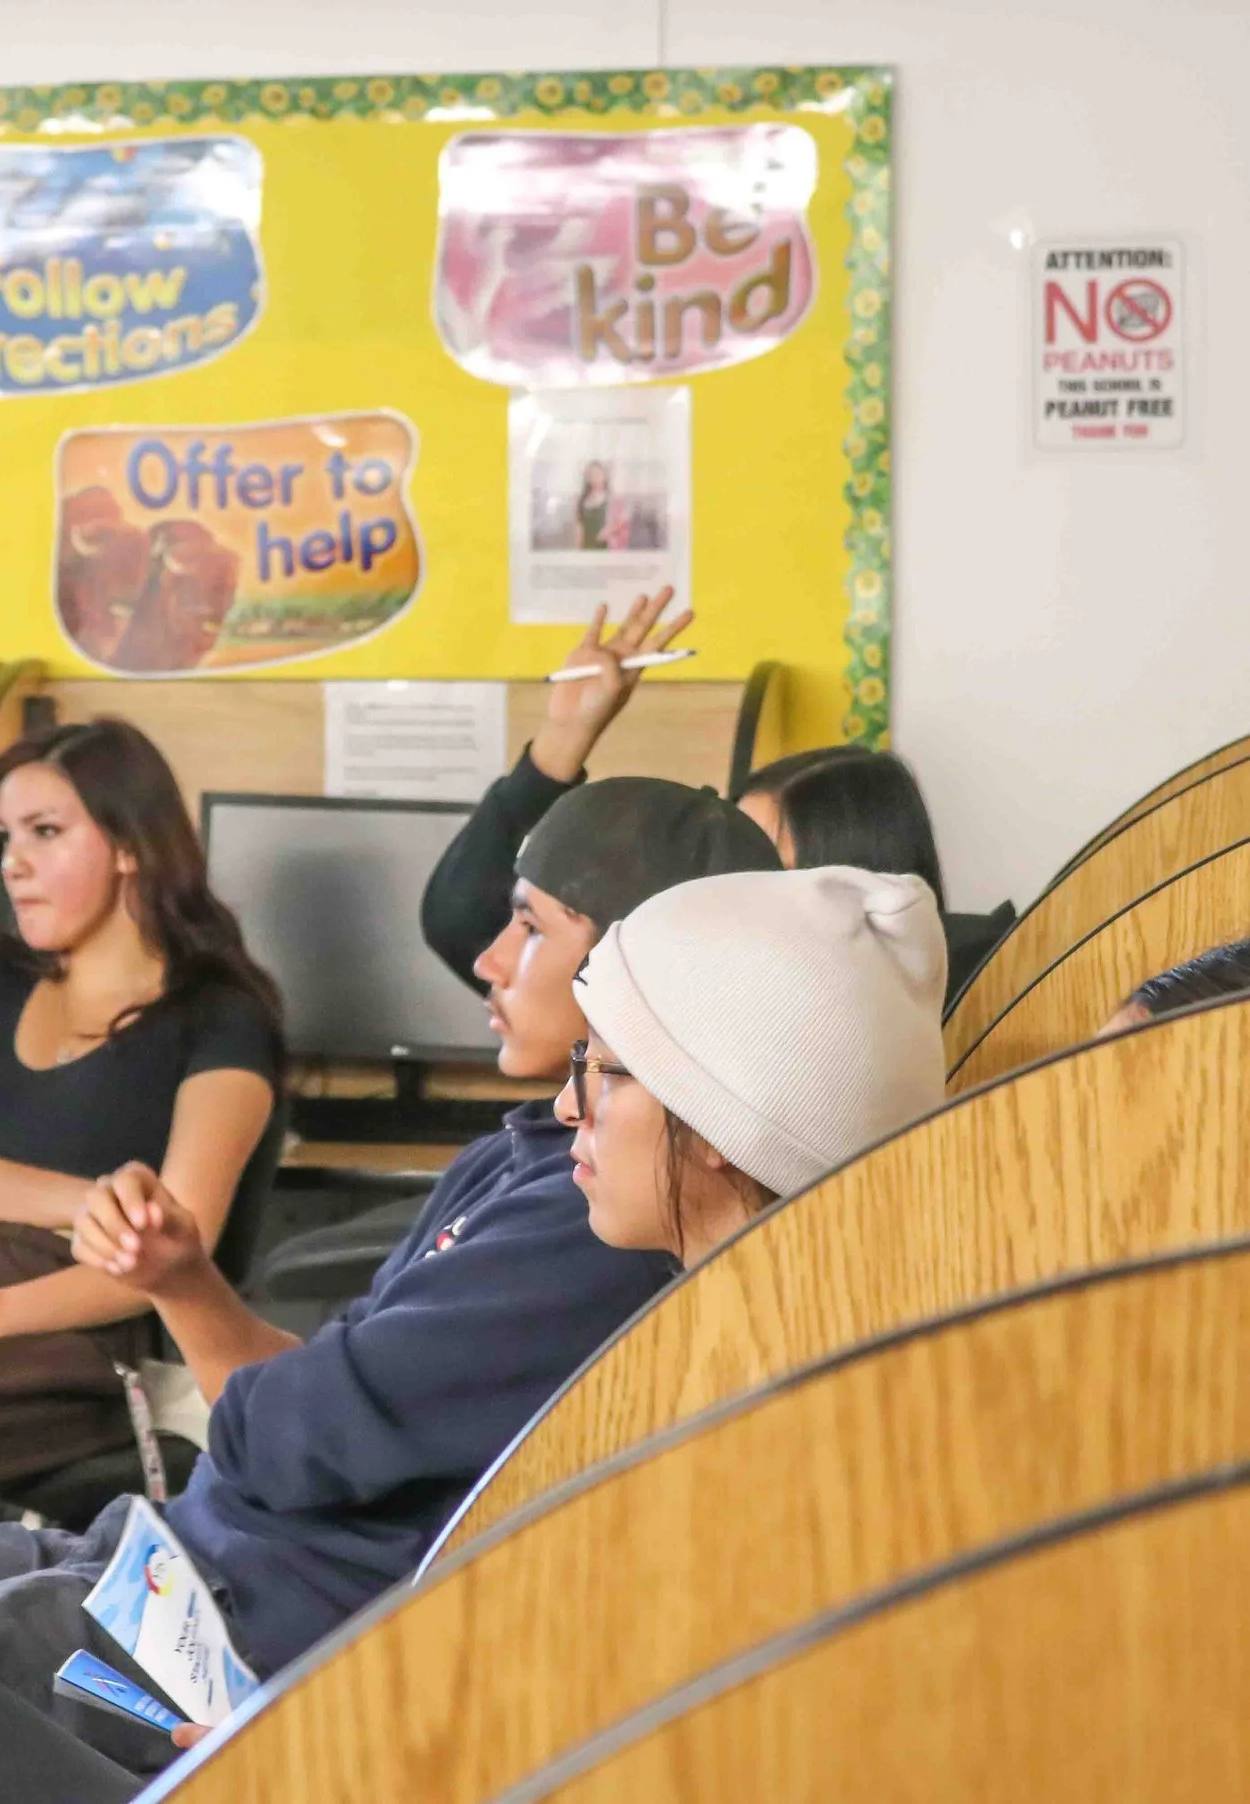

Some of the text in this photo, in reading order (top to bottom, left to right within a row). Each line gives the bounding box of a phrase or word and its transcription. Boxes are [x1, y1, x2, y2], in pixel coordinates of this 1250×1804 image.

[636, 183, 761, 265] Be
[577, 239, 792, 364] kind
[1043, 350, 1174, 372] PEANUTS
[1045, 398, 1173, 418] PEANUT FREE
[127, 439, 394, 509] Offer to
[257, 511, 397, 582] help
